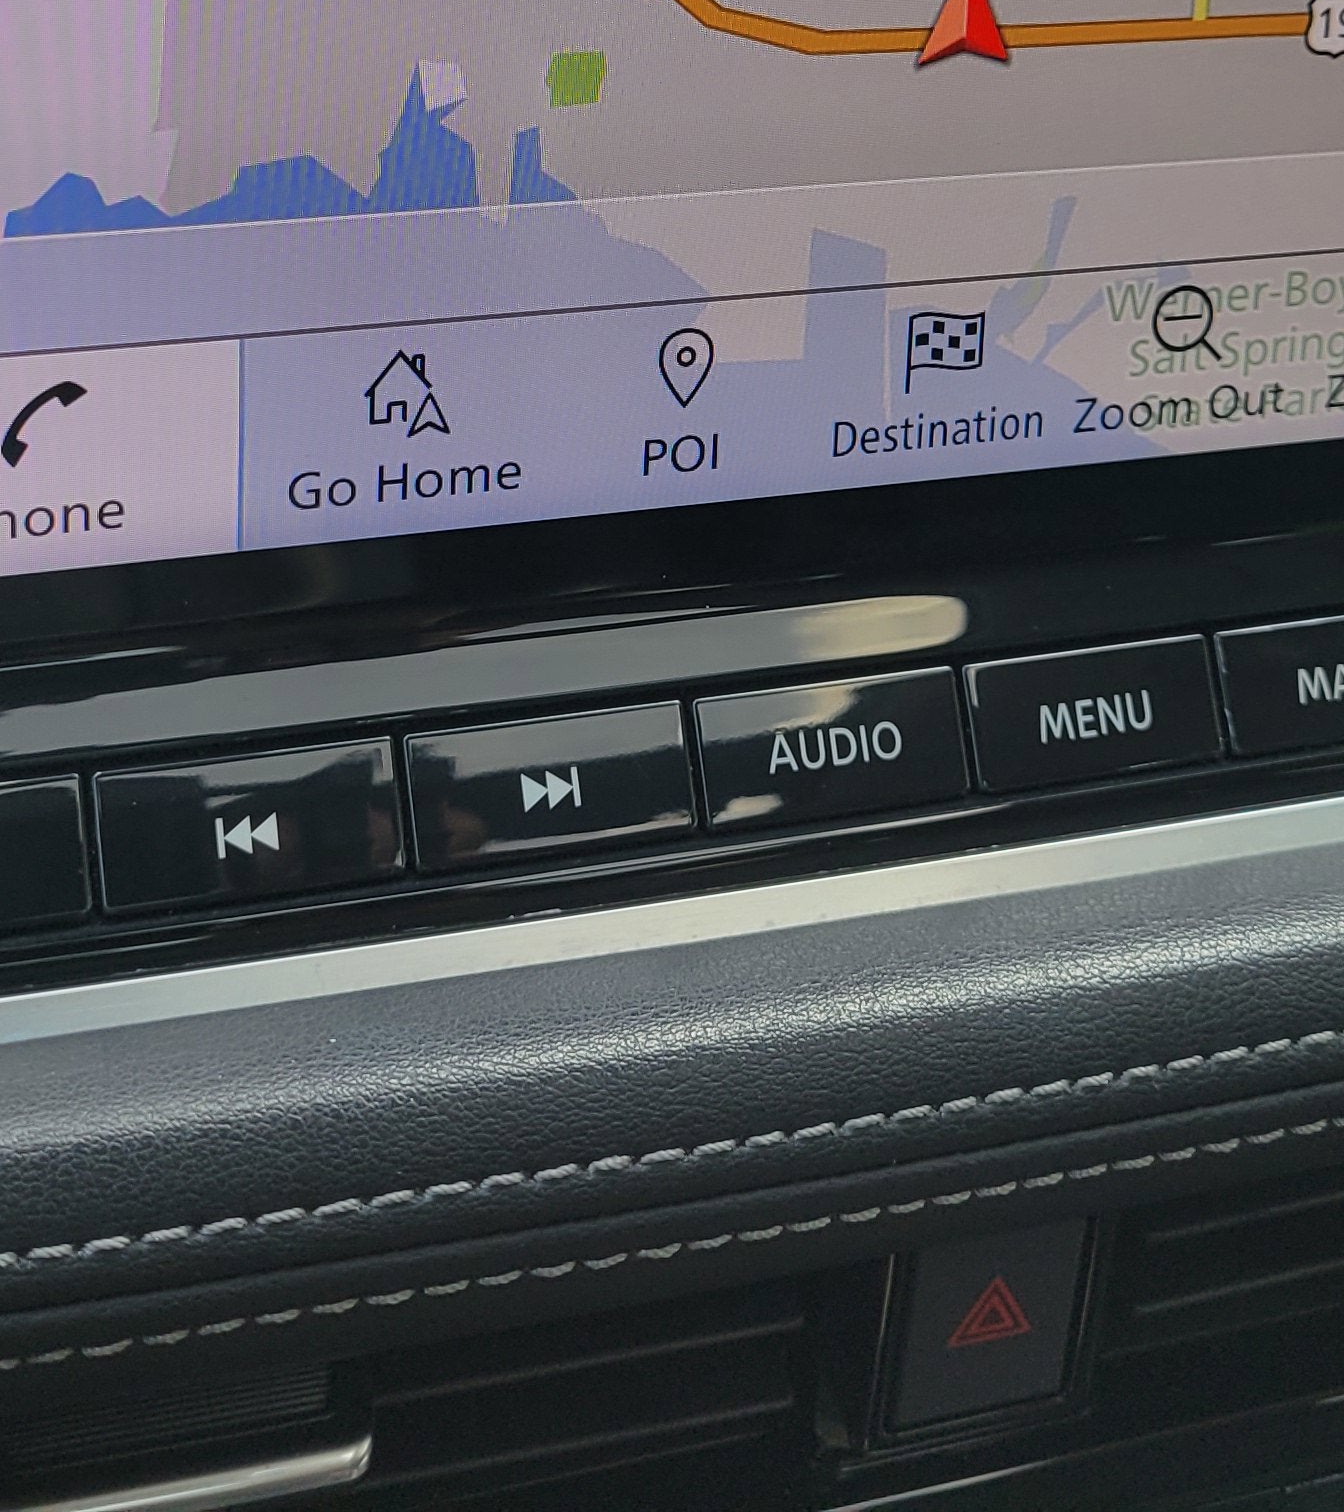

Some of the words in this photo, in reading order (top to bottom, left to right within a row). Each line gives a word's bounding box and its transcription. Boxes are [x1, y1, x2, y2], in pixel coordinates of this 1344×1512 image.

[832, 406, 1044, 458] Destination
[1072, 396, 1192, 434] Zoom
[1208, 381, 1285, 421] Out
[642, 433, 719, 476] POI
[288, 471, 358, 511] Go
[376, 459, 523, 503] Home
[1039, 690, 1154, 745] MENU
[768, 720, 904, 775] AUDIO
